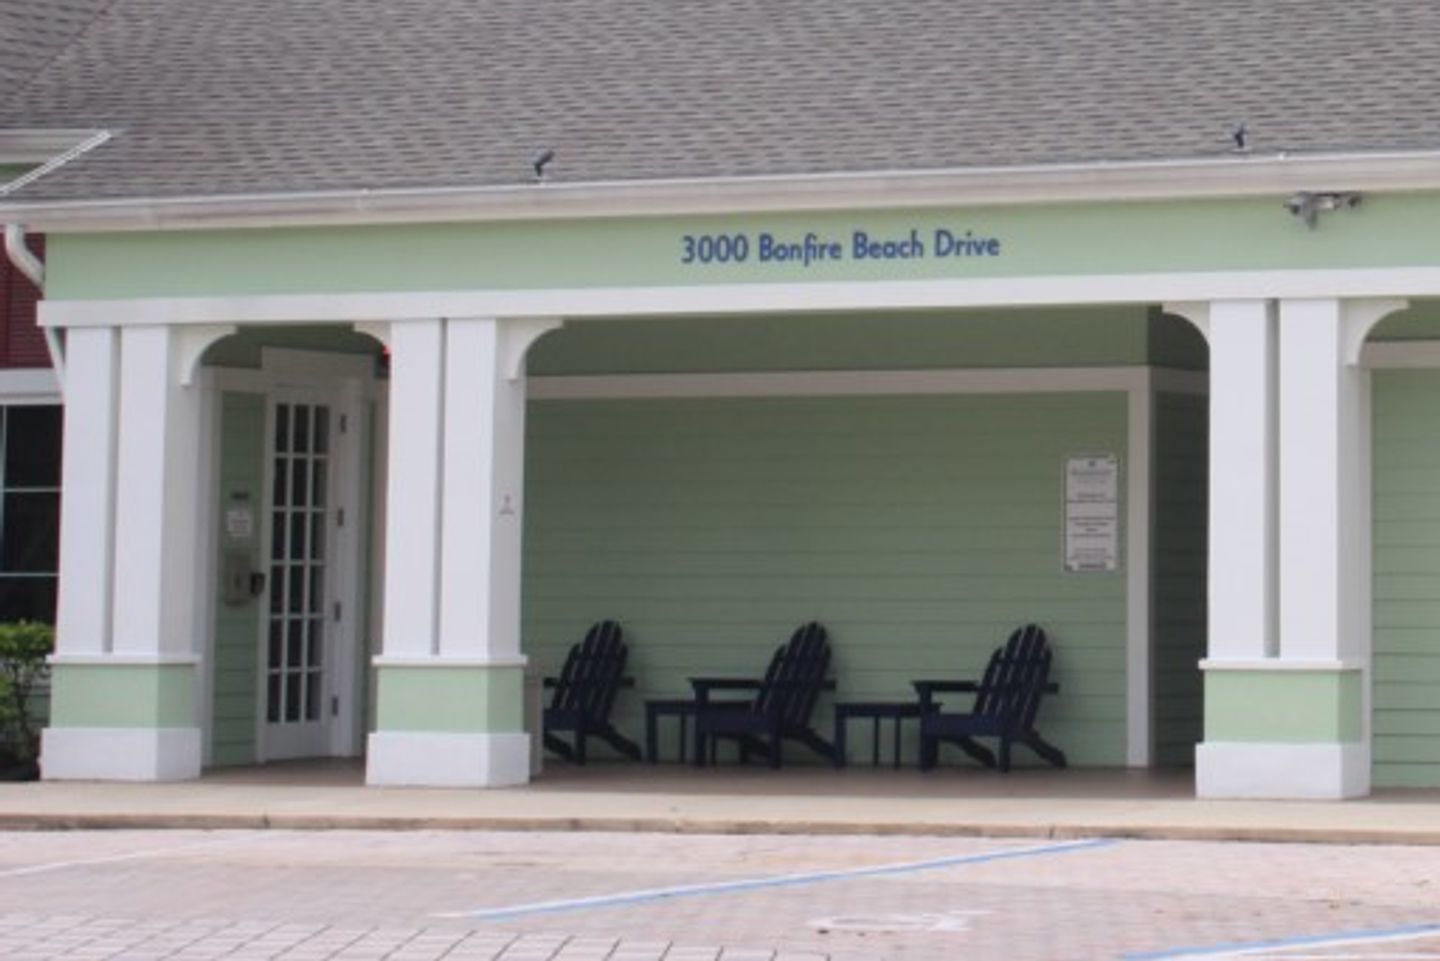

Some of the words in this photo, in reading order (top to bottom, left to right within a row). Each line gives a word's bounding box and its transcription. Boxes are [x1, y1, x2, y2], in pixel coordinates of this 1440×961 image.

[681, 235, 749, 263] 3000
[758, 233, 842, 267] Bonfire
[852, 229, 924, 259] Beach
[934, 229, 1001, 257] Drive
